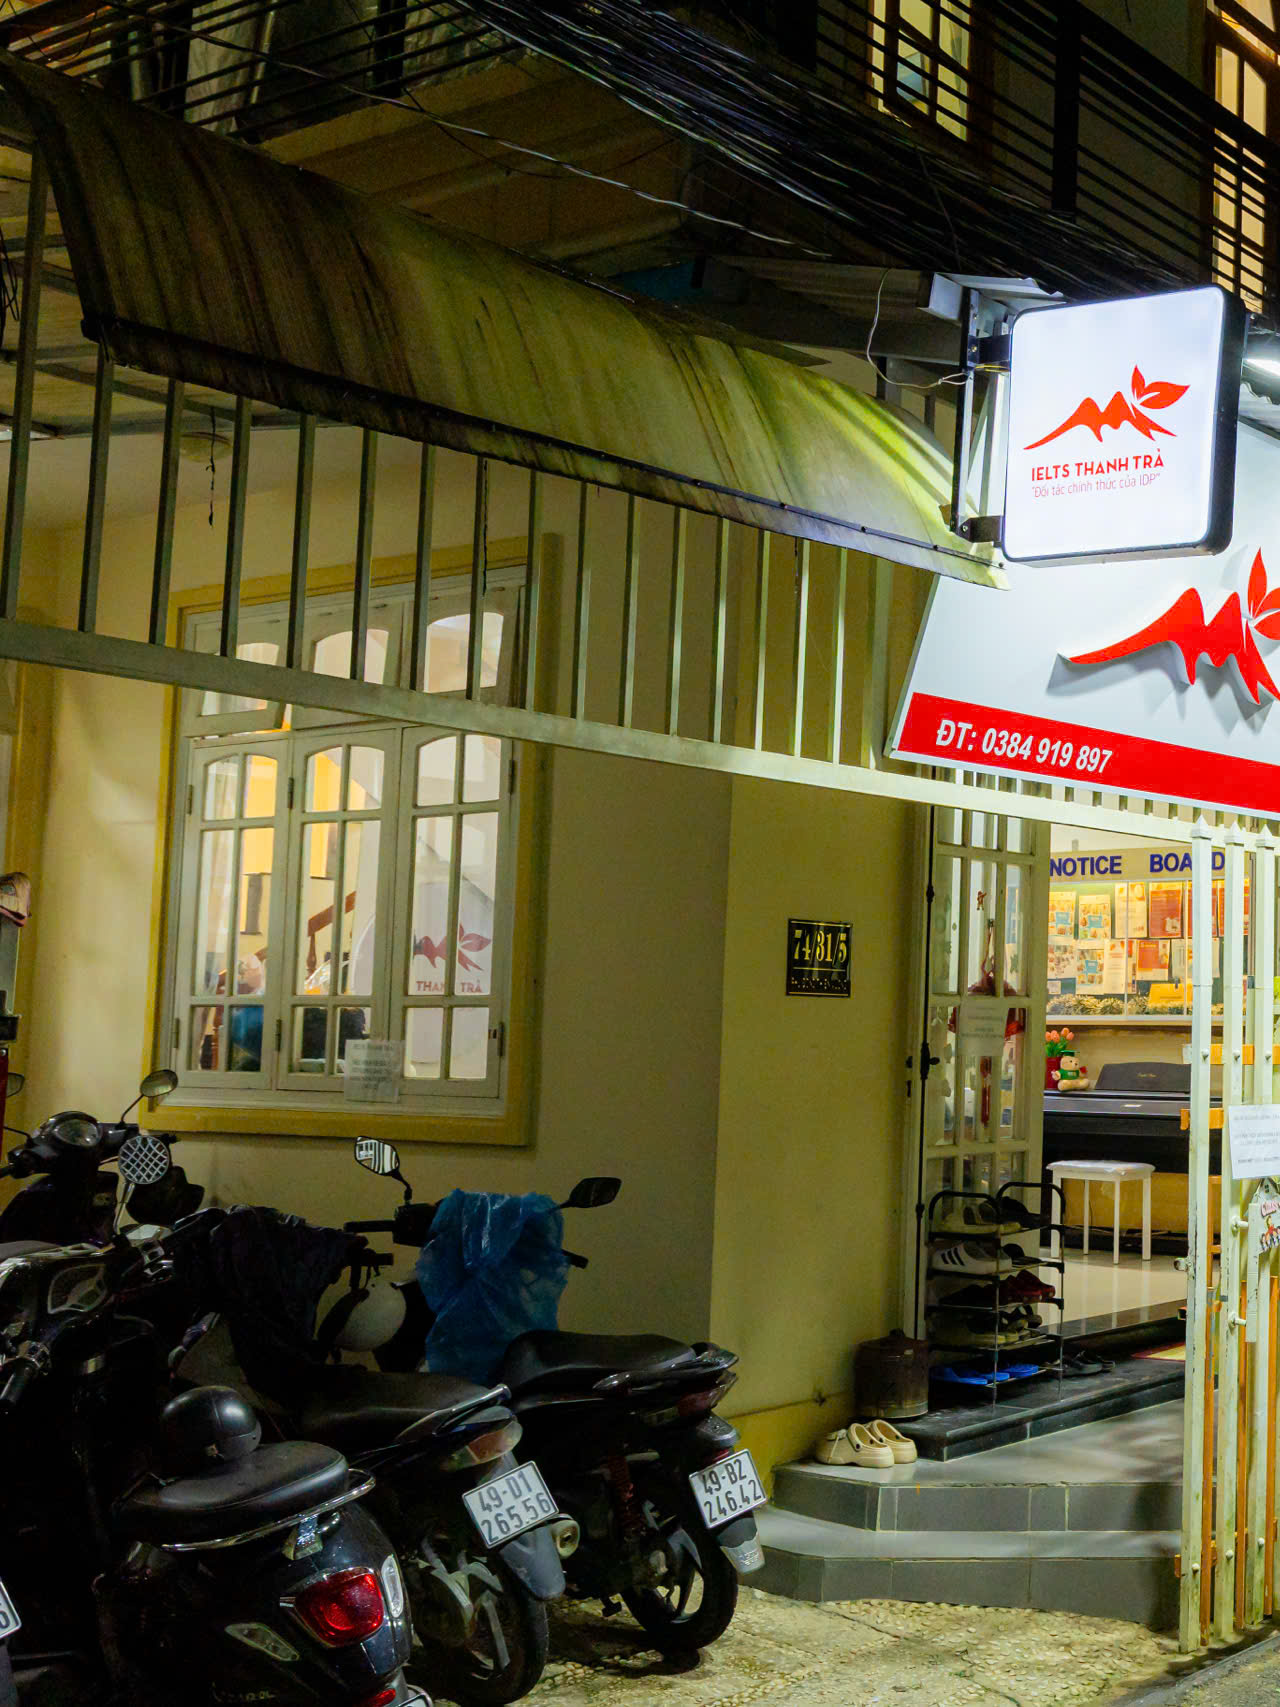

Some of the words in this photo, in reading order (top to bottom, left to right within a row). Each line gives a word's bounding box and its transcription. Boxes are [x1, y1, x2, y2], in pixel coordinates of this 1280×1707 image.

[1032, 464, 1070, 481] IELTS
[1075, 457, 1129, 477] THANH
[1068, 480, 1092, 494] chính
[1096, 477, 1116, 491] thức
[1119, 474, 1136, 489] của
[936, 719, 977, 751] ĐT:
[981, 728, 1034, 760] 0384
[1036, 738, 1073, 767] 919
[1075, 745, 1113, 773] 897
[1050, 855, 1122, 877] NOTICE
[1150, 851, 1225, 873] BOAD
[478, 1471, 532, 1513] 49-D1
[702, 1459, 747, 1496] 49-B2
[481, 1492, 551, 1543] 265.56
[704, 1480, 762, 1523] 246.42
